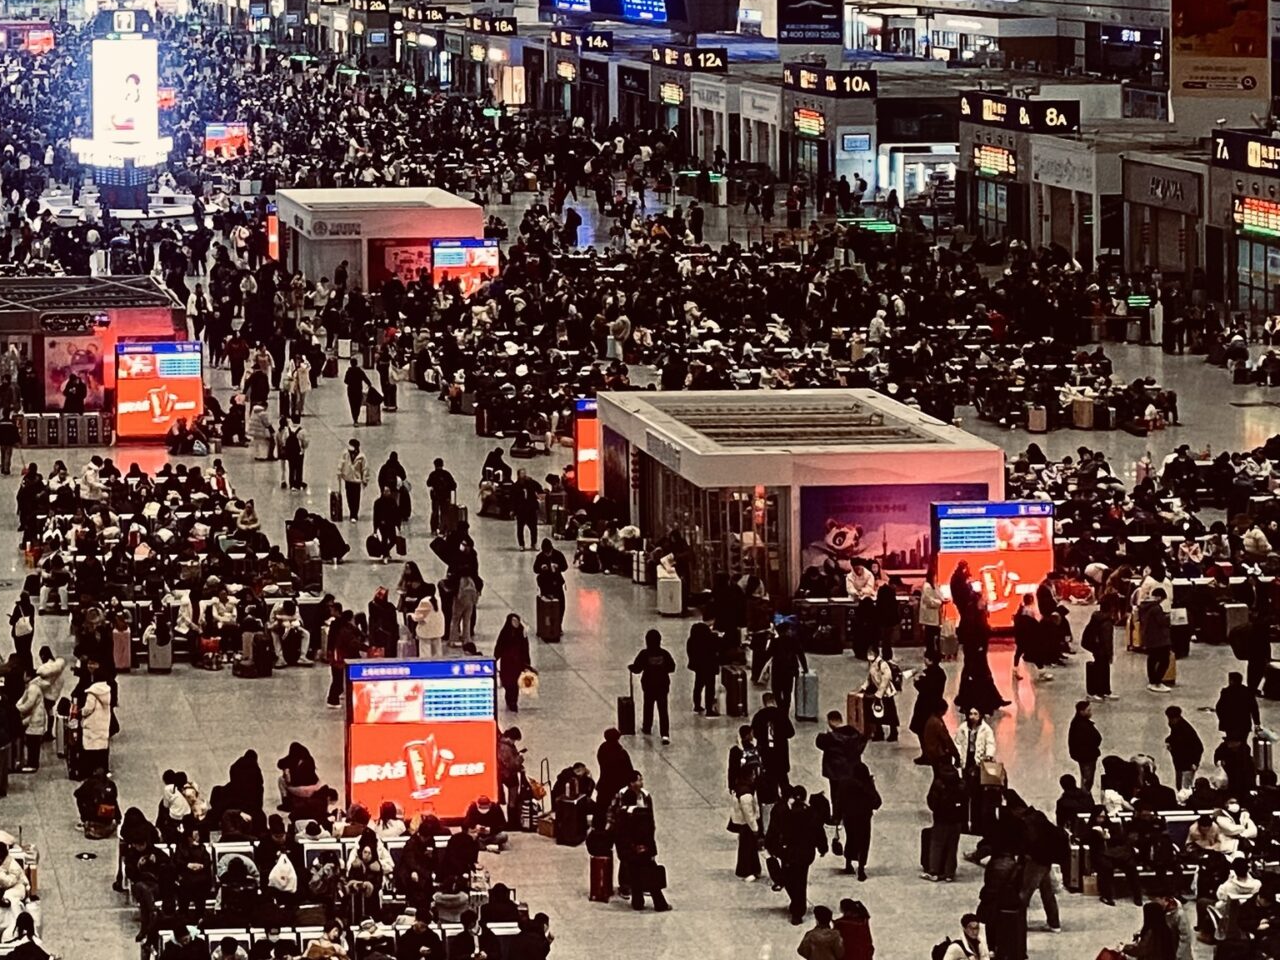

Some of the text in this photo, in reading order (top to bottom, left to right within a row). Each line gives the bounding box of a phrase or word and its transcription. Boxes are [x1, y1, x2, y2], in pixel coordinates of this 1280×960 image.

[586, 35, 609, 48] 14A
[698, 52, 722, 68] 12A
[843, 76, 870, 92] 10A
[1046, 107, 1067, 126] 8A
[1216, 138, 1230, 160] 7A
